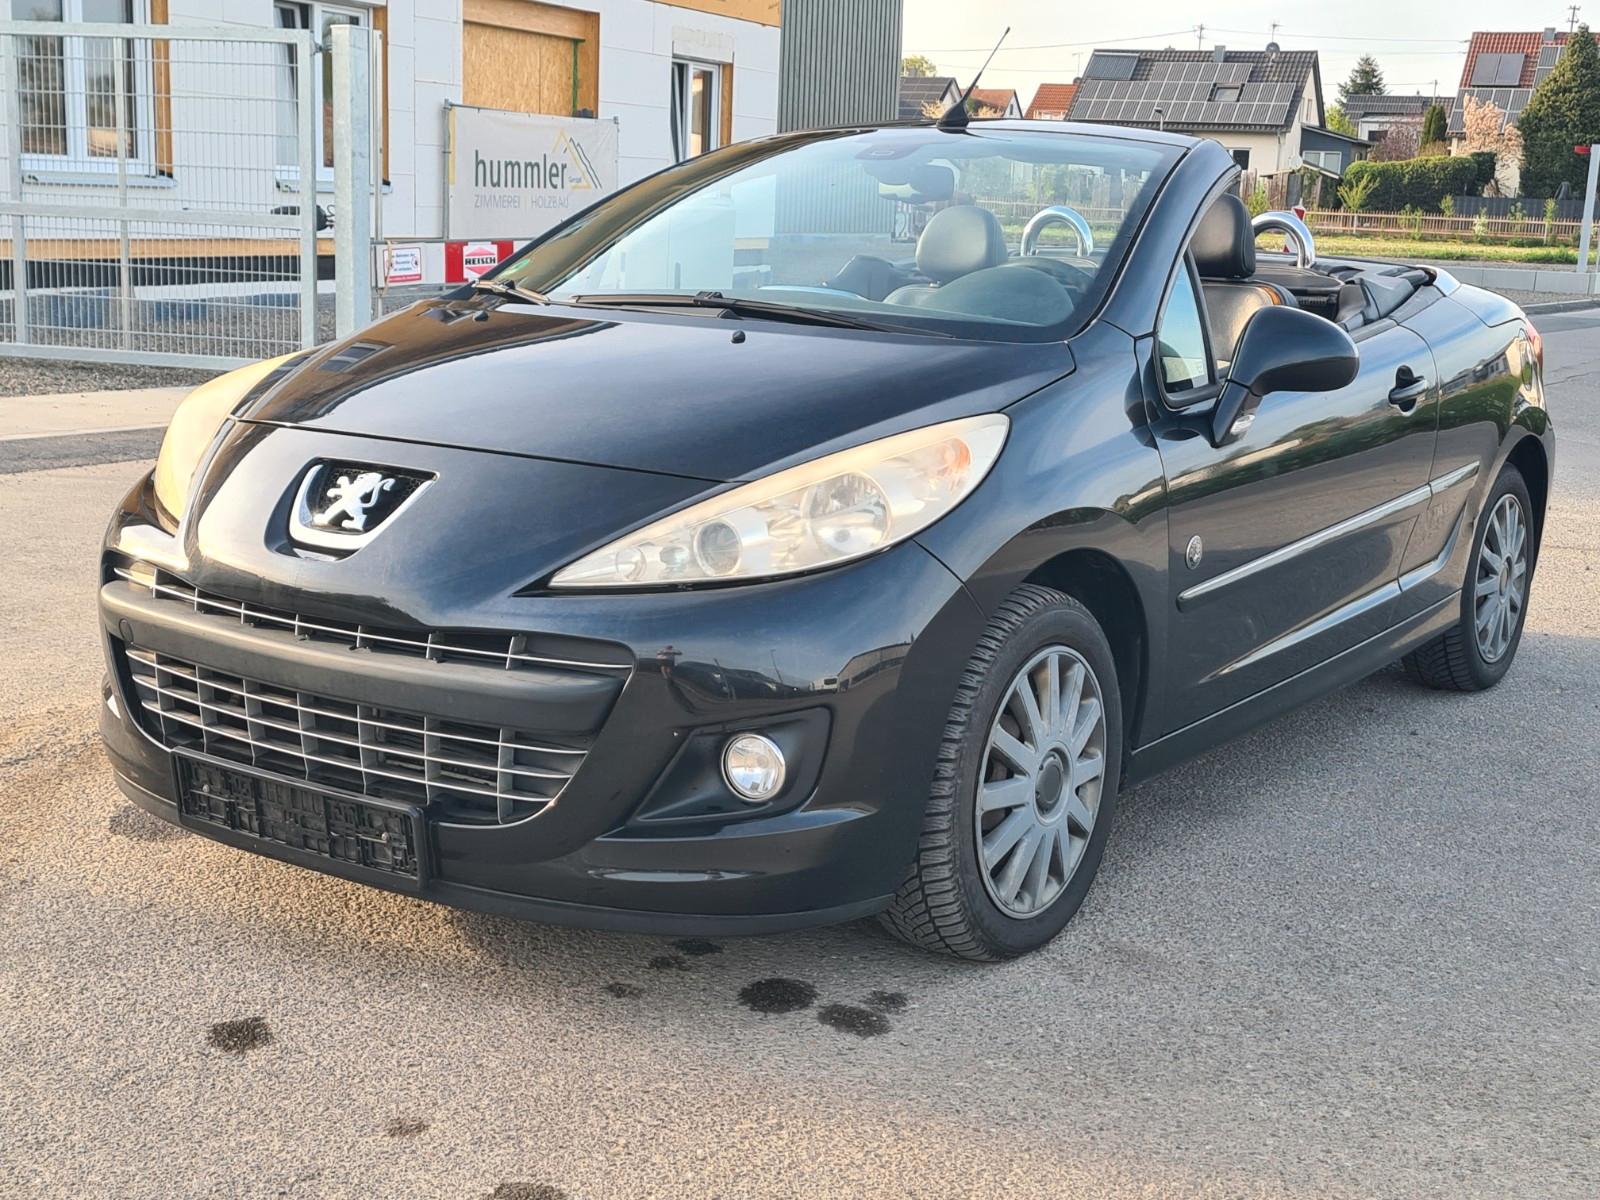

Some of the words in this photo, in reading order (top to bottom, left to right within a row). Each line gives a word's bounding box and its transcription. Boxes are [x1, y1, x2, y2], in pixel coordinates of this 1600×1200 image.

[474, 149, 567, 189] hummler
[474, 194, 521, 209] ZIMMEREI
[531, 195, 569, 209] HOLZBAU
[464, 257, 496, 266] REISCH
